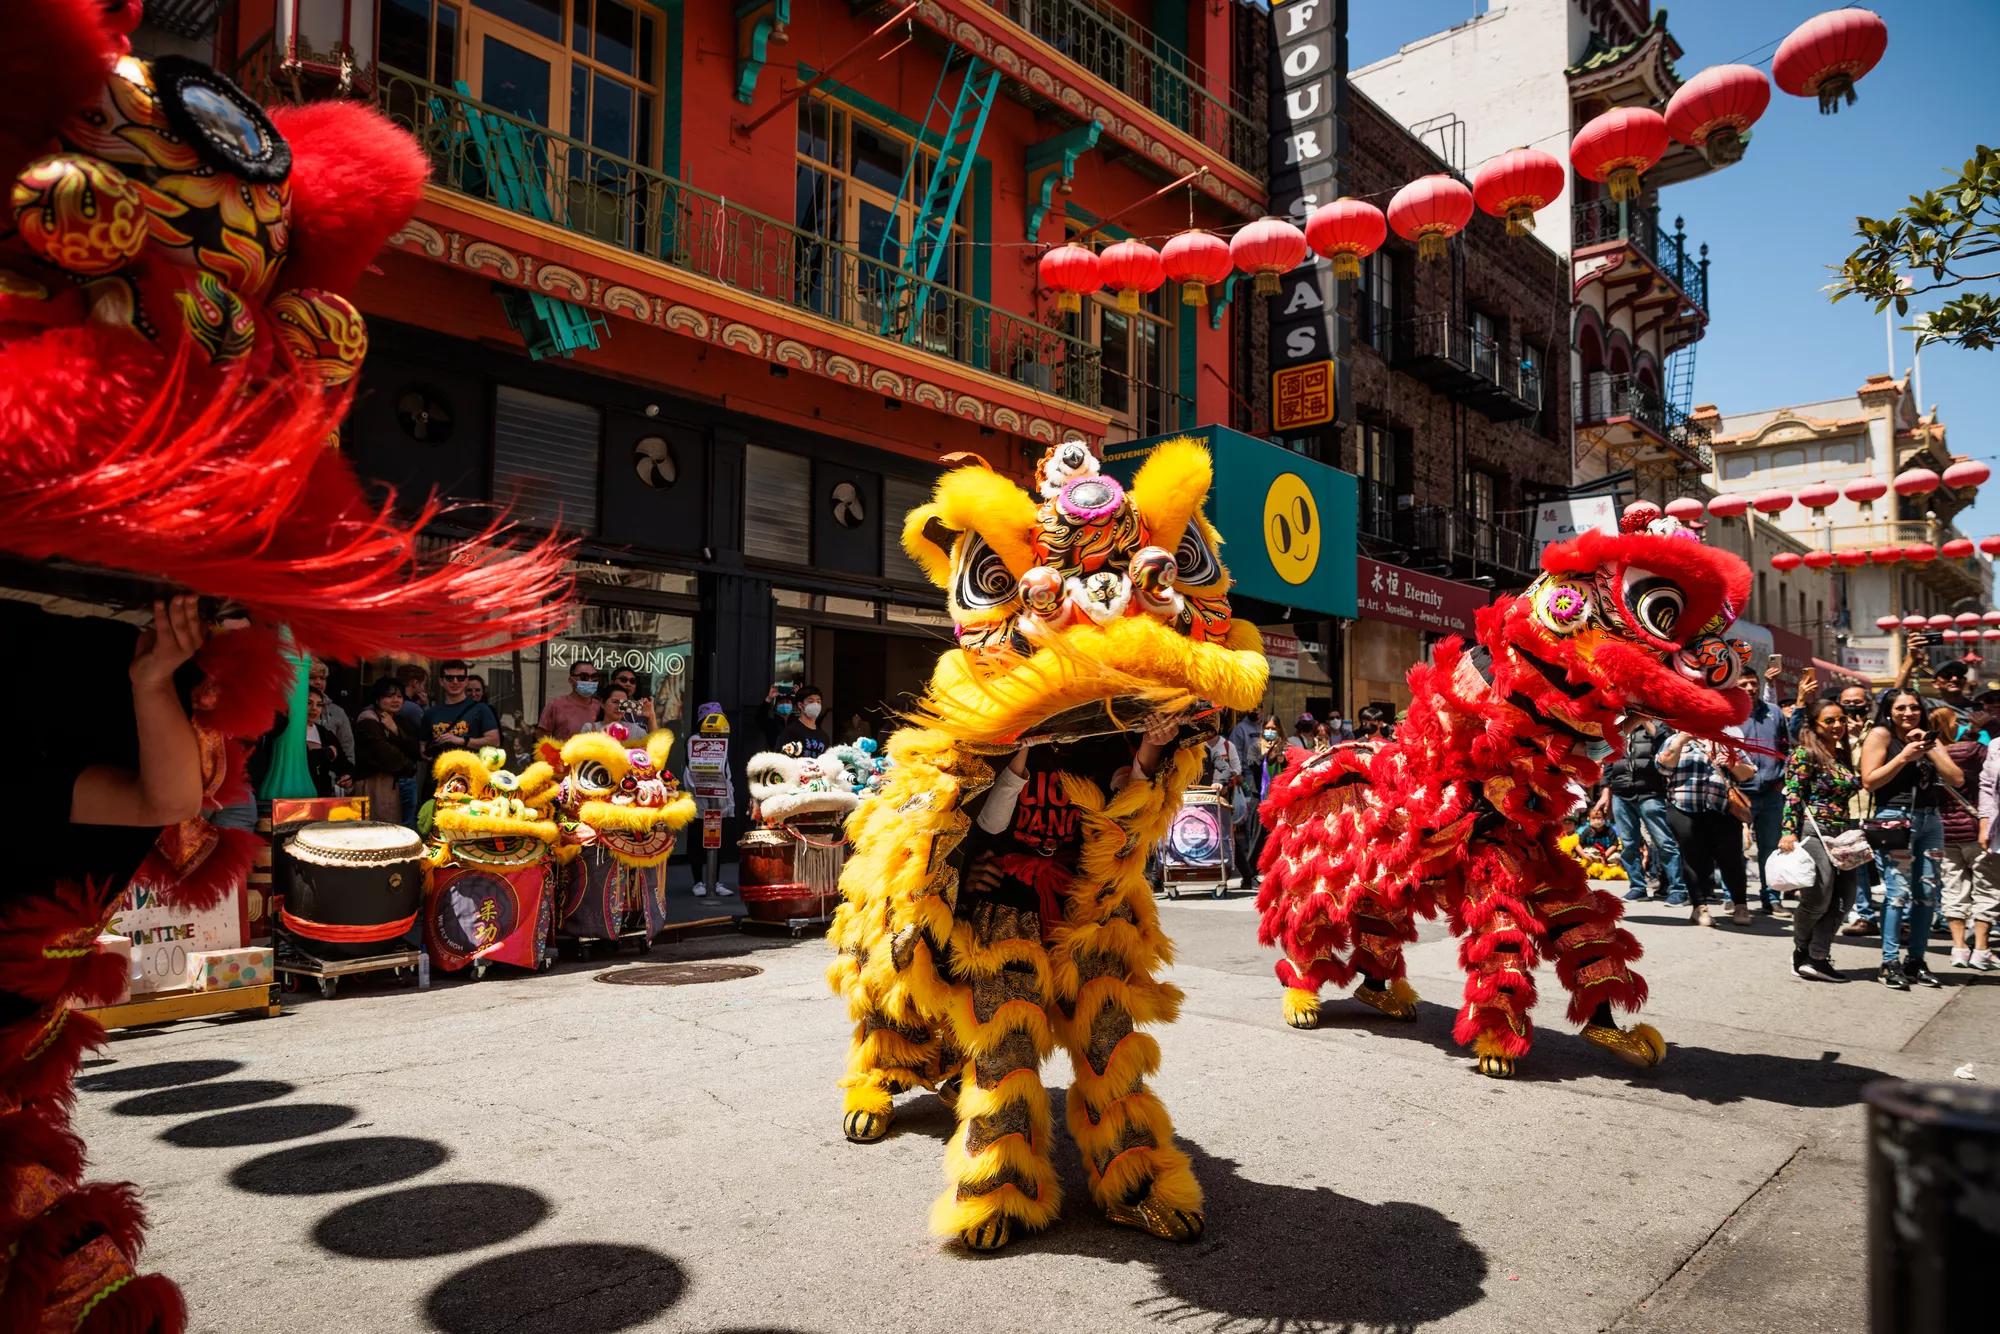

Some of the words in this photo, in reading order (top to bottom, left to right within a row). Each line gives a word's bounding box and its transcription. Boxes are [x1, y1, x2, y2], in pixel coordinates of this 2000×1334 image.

[1284, 0, 1322, 166] FOUR
[1284, 194, 1323, 358] SAS
[1404, 582, 1443, 610] Eternity
[1366, 598, 1379, 611] Art
[1385, 602, 1413, 618] Novelties
[1420, 610, 1442, 627] Jewelry
[1020, 771, 1072, 807] LIO
[1017, 805, 1081, 836] DANC
[446, 939, 464, 952] HIGH
